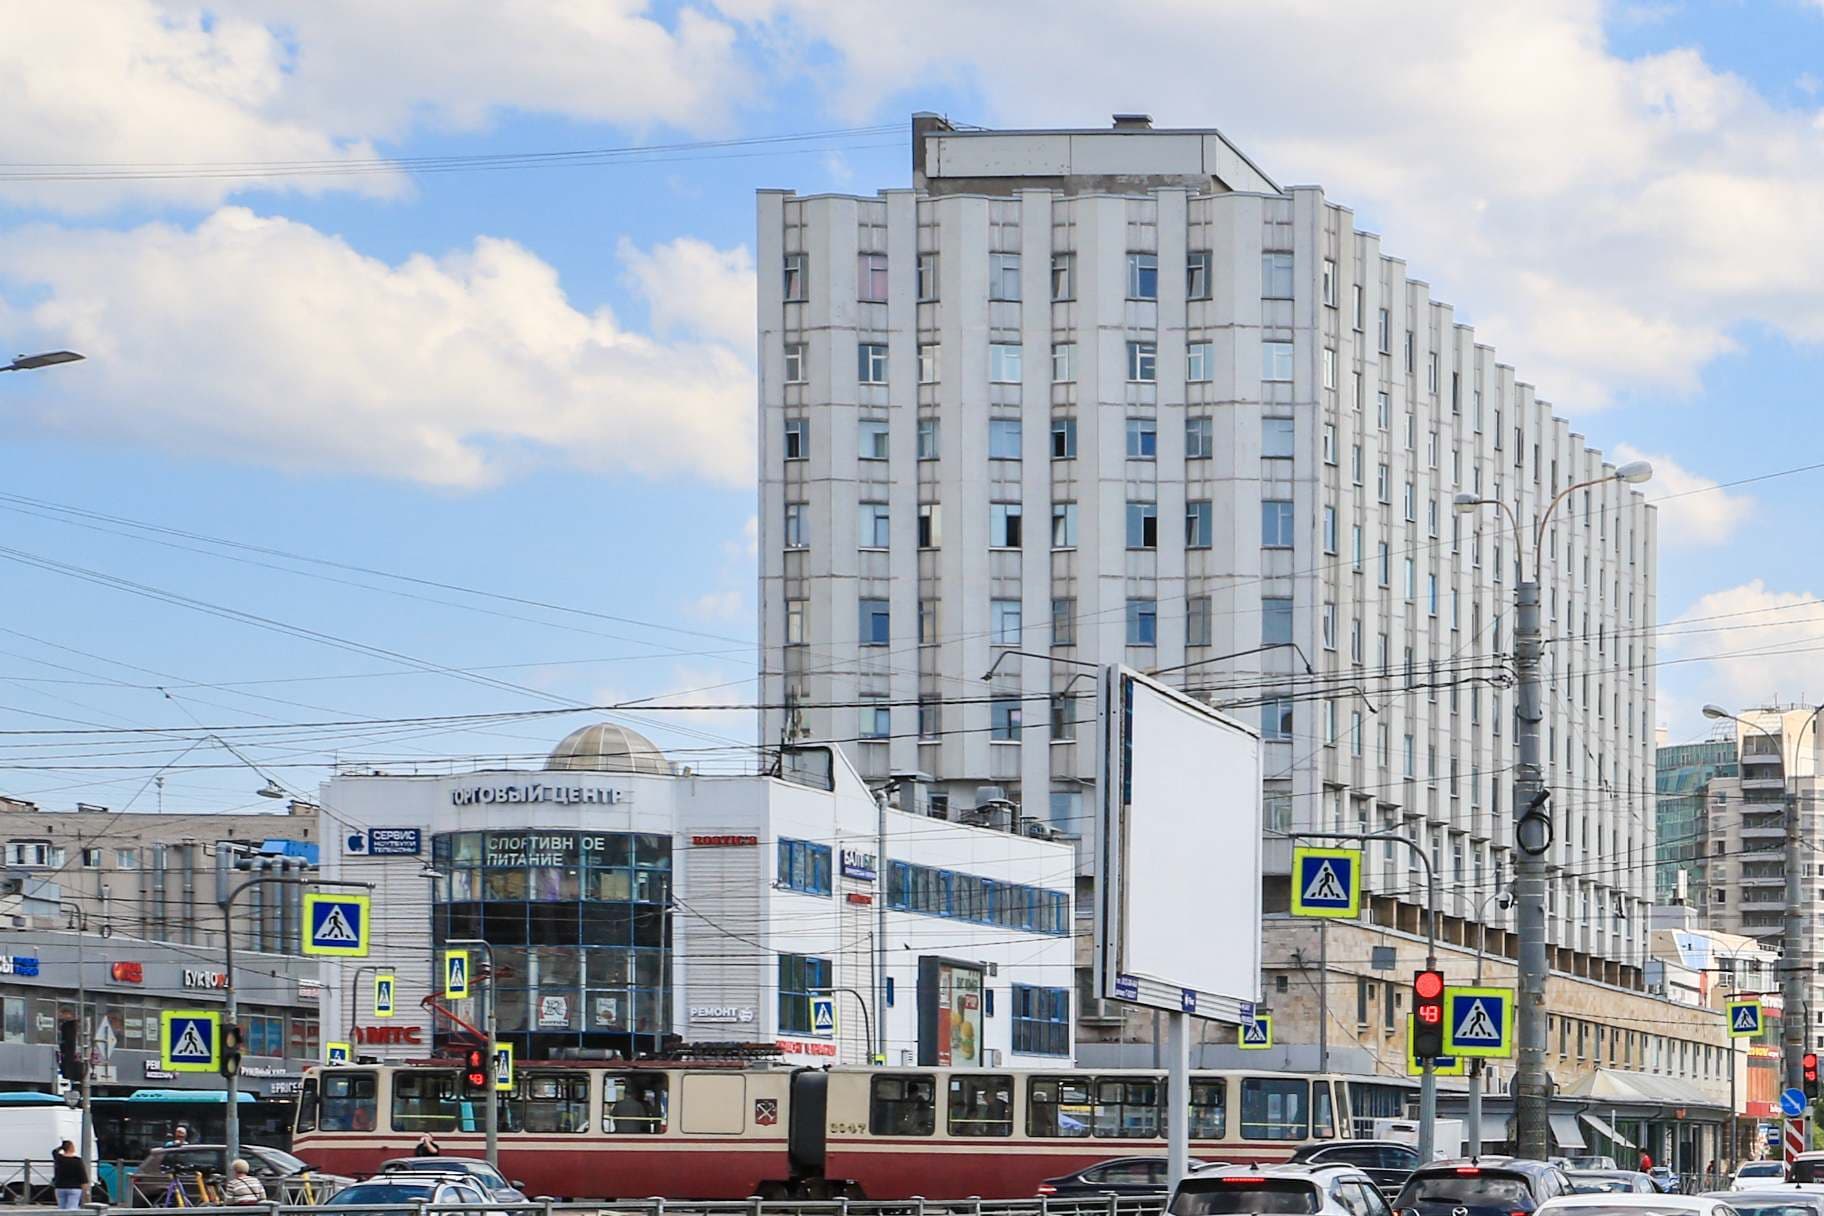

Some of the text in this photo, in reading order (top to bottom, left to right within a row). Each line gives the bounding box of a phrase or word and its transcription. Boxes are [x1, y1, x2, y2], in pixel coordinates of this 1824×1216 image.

[373, 831, 416, 840] СЕРВИС
[487, 853, 563, 866] ПИТАНИЕ
[690, 1007, 738, 1017] РЕМОНТ
[1419, 1005, 1439, 1023] 43
